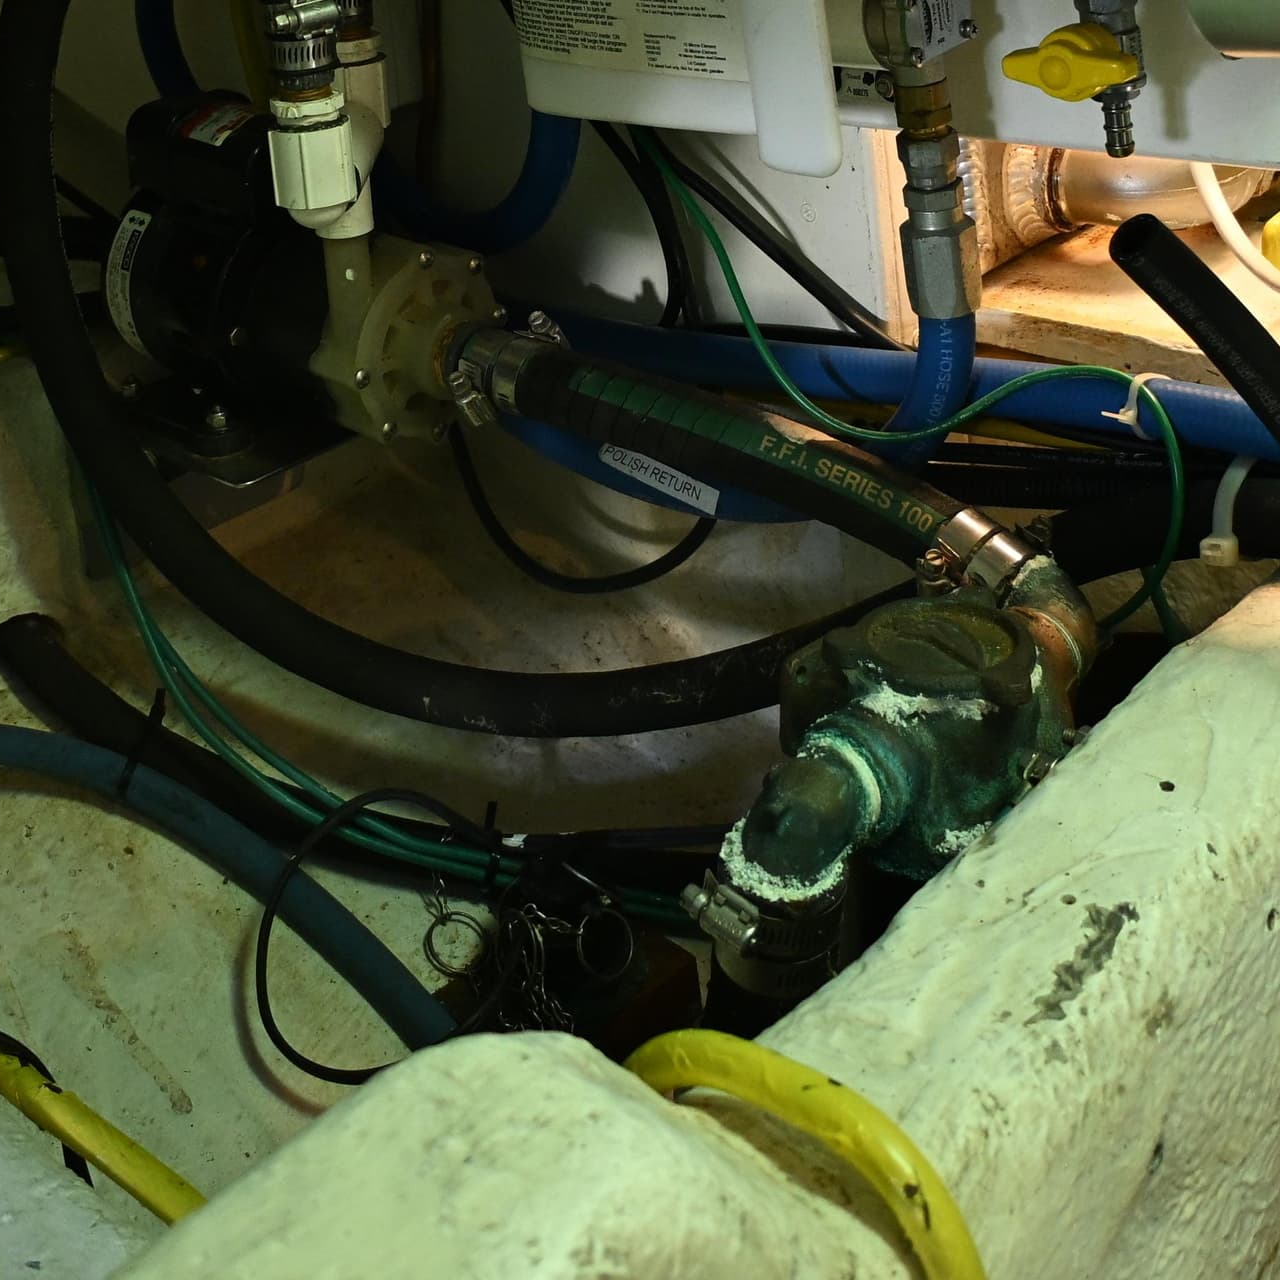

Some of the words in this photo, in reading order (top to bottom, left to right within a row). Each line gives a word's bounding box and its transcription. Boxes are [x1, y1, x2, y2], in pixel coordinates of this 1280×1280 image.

[935, 349, 953, 393] HOSE
[603, 446, 651, 475] POLISH
[649, 466, 702, 501] RETURN
[759, 436, 809, 471] F.F.I.
[814, 459, 895, 510] SERIES
[896, 501, 934, 533] 100
